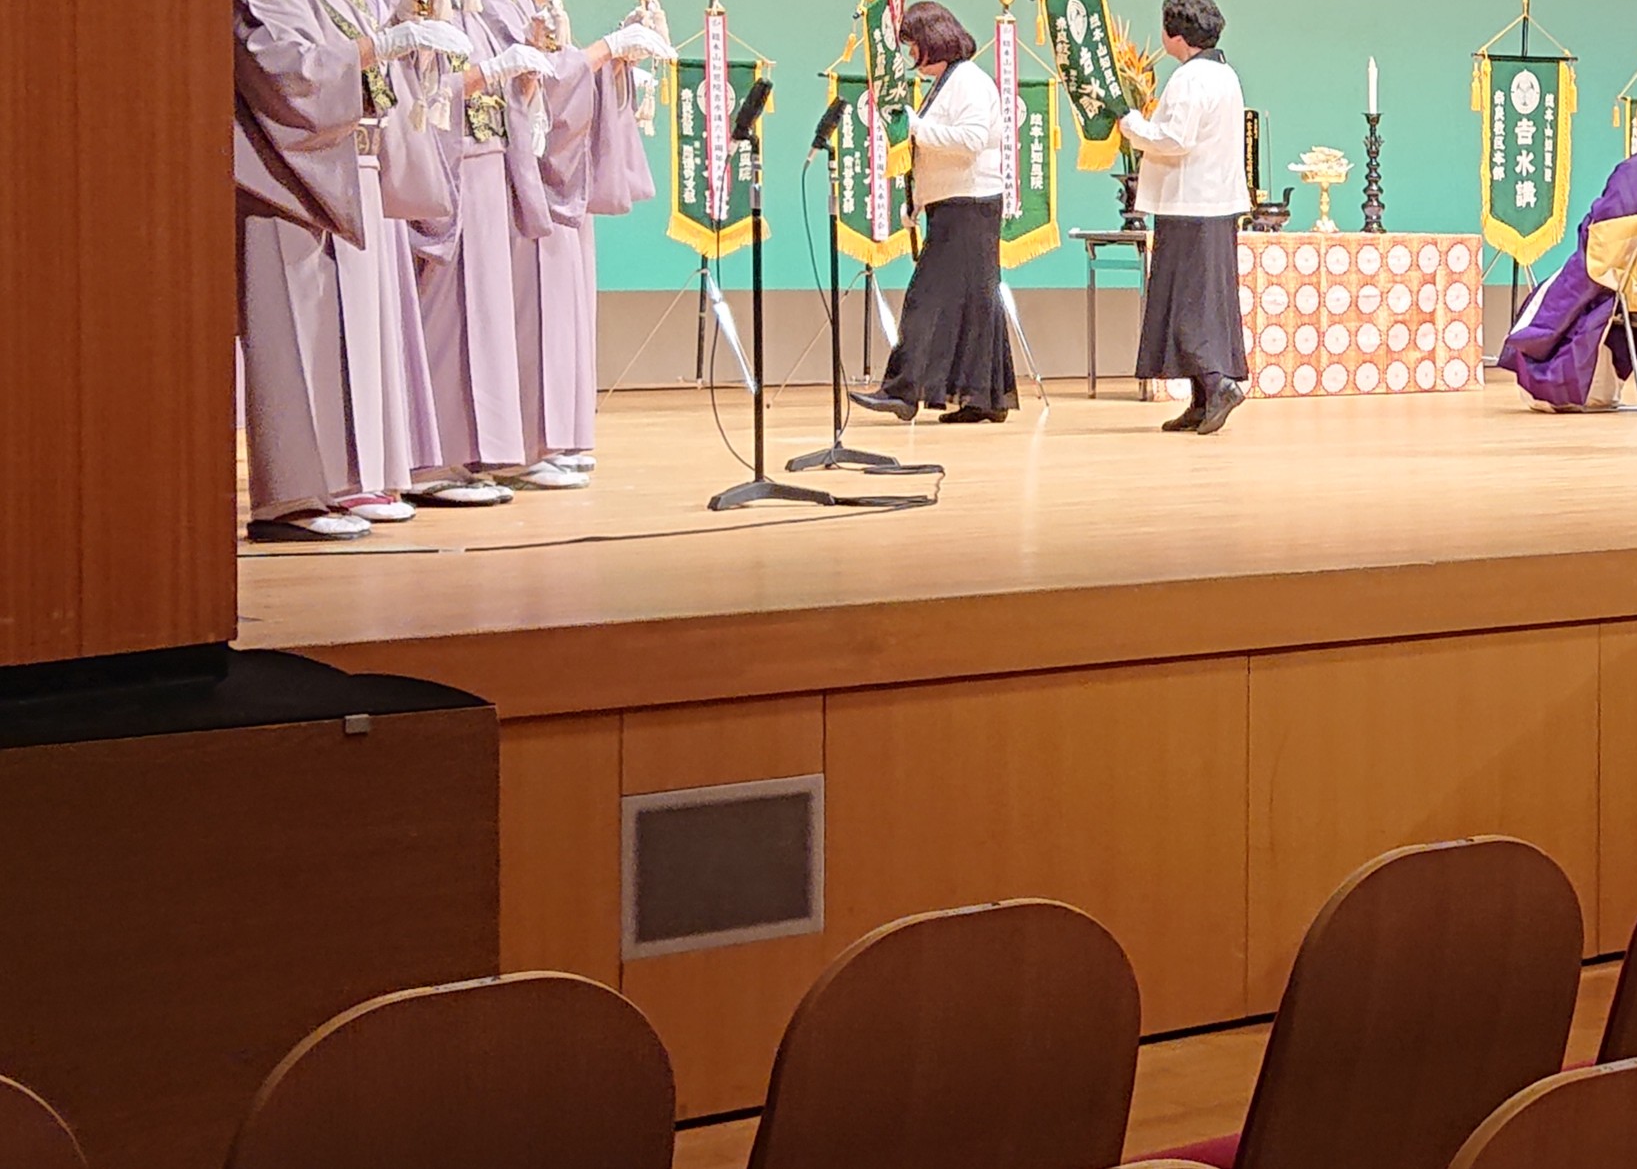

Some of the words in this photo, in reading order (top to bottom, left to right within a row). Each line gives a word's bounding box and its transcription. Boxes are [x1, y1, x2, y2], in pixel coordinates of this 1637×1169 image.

[1492, 89, 1506, 182] 奈良教区本部
[1514, 117, 1537, 208] 吉水講
